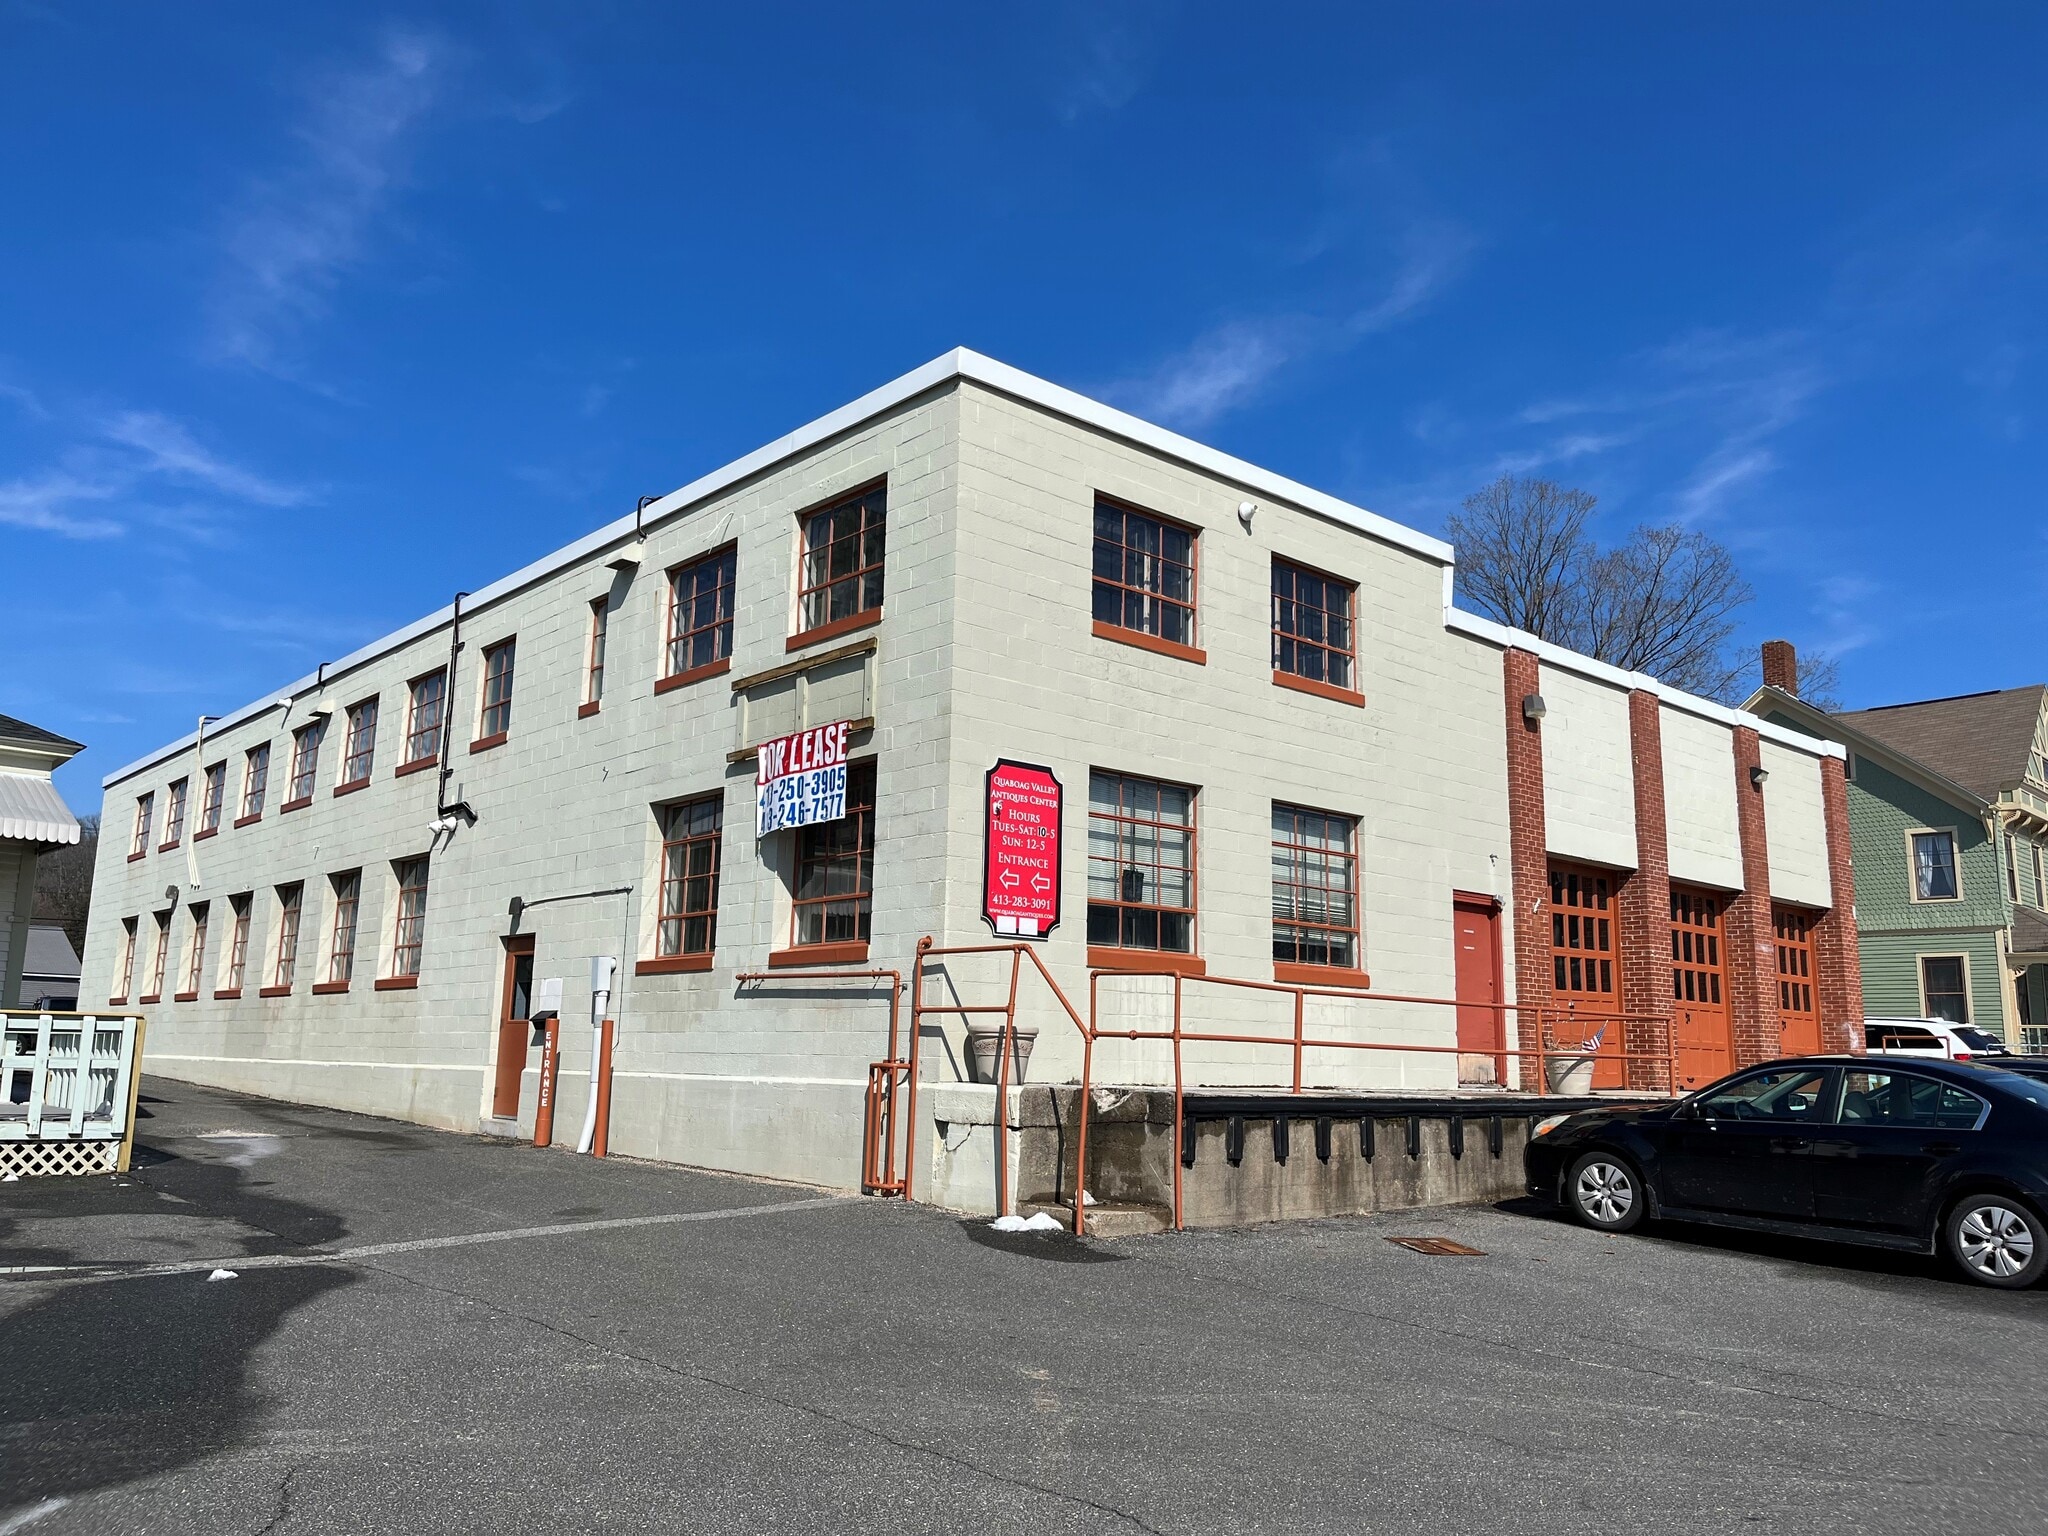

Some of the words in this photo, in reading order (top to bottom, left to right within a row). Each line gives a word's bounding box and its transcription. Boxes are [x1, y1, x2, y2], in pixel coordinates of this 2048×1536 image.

[789, 722, 848, 772] LEASE
[993, 775, 1030, 791] QUABOAG
[1031, 782, 1057, 795] VALLEY
[991, 789, 1028, 804] ANTIQUES
[1029, 795, 1058, 809] CENTER
[1009, 809, 1041, 823] HOURS
[1002, 835, 1024, 848] SUN:
[1026, 838, 1045, 851] 12-5
[998, 852, 1049, 869] ENTRANCE
[992, 894, 1051, 910] 413-283-3091
[541, 1031, 551, 1107] ENTRANCE
